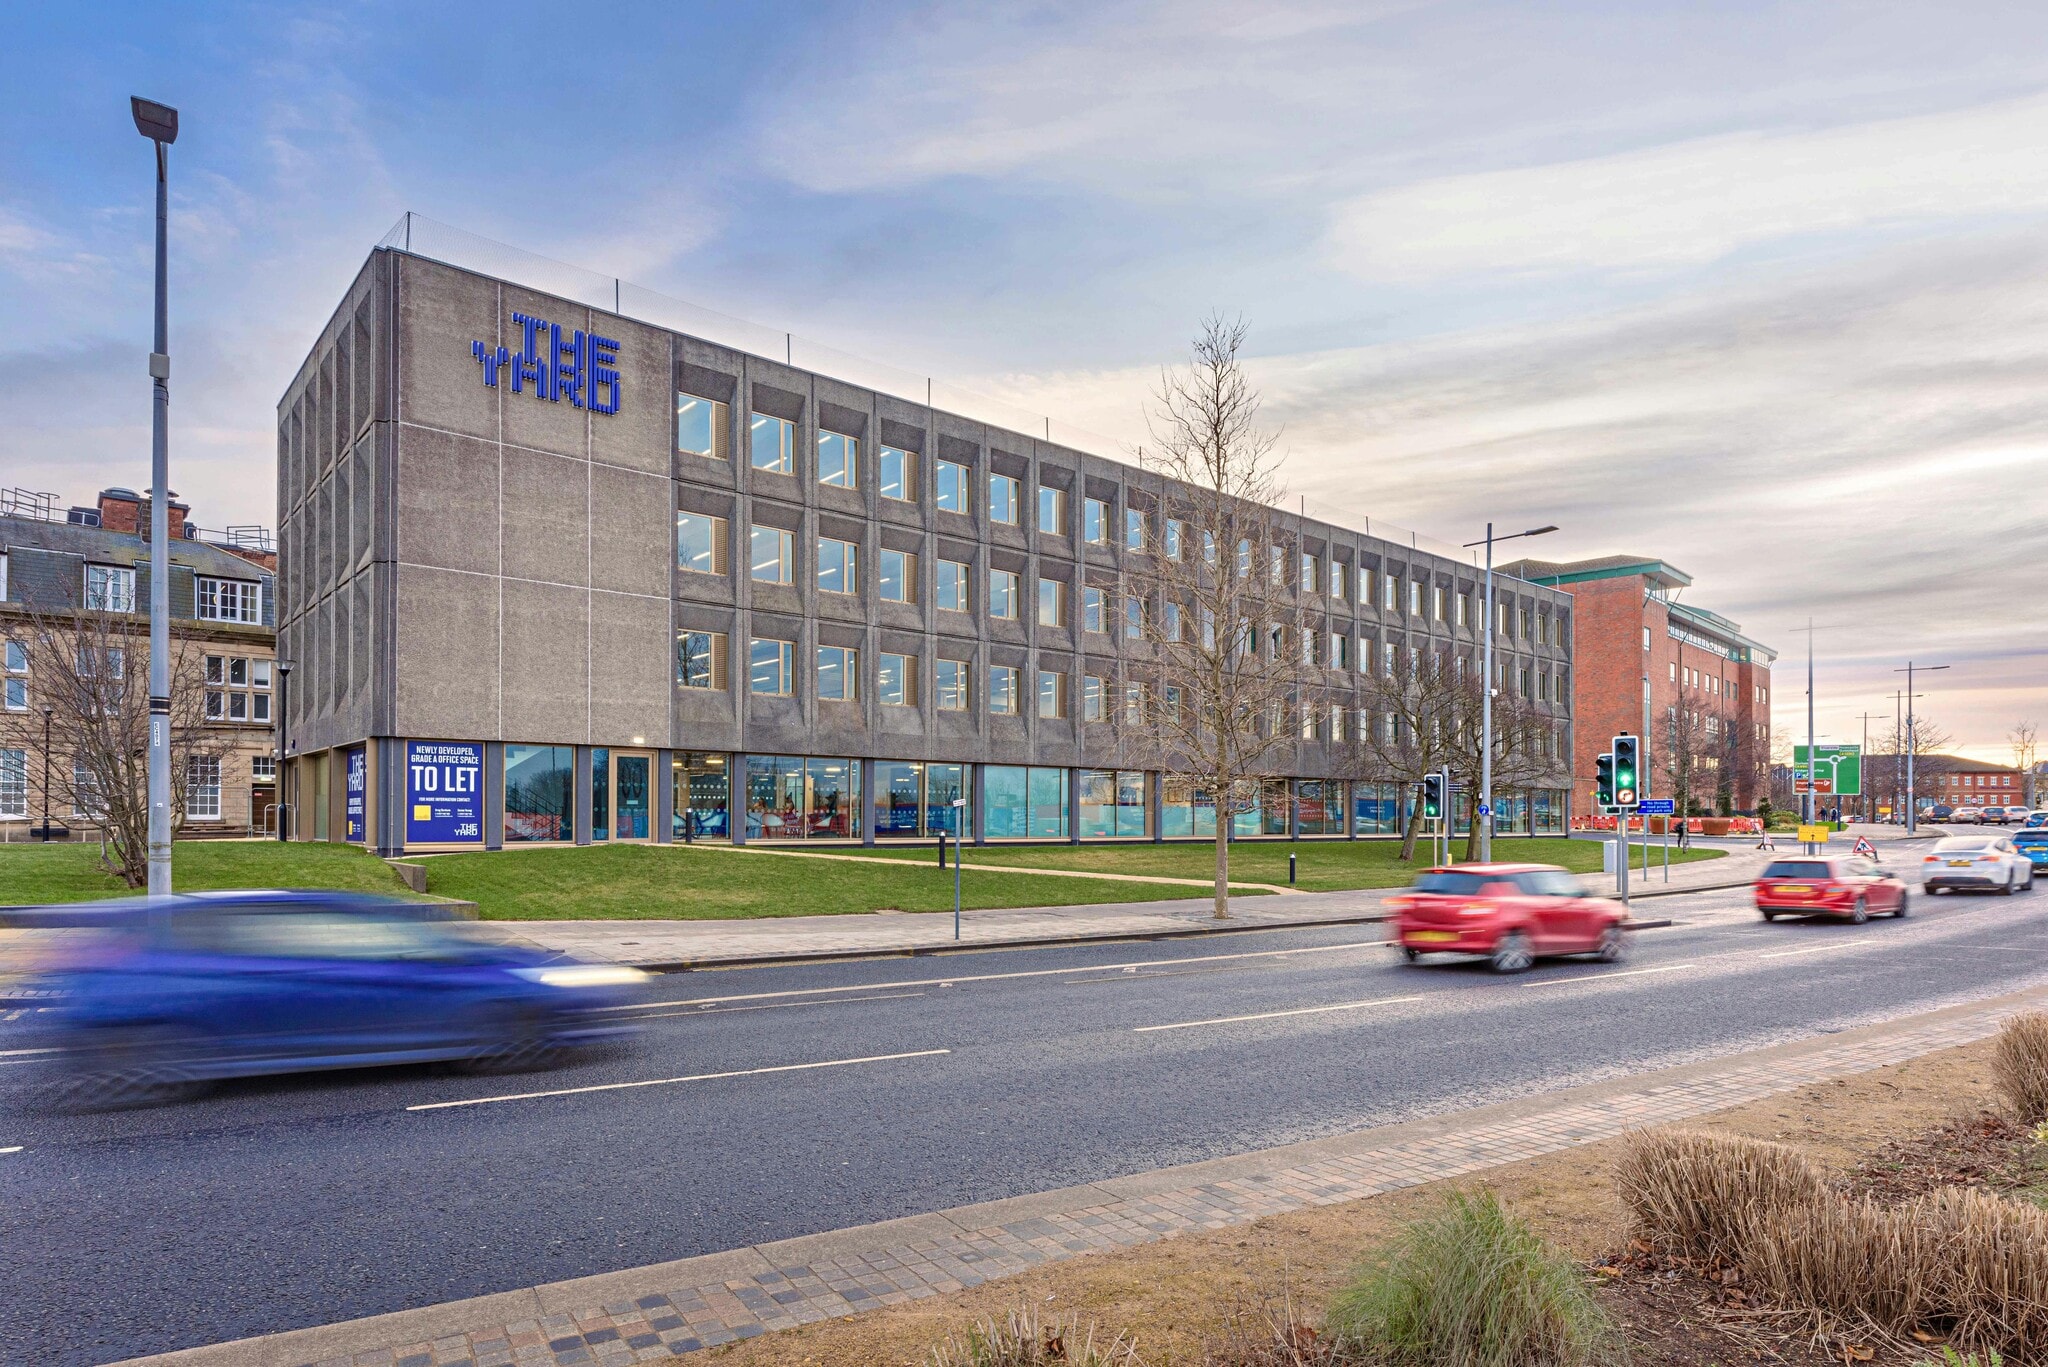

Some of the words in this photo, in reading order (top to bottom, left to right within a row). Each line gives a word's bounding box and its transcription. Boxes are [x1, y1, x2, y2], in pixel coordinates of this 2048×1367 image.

[511, 311, 620, 383] THE
[471, 340, 620, 416] YARD
[411, 754, 432, 763] GRADE
[433, 755, 438, 763] A
[438, 755, 459, 764] OFFICE
[459, 756, 479, 764] SPACE
[416, 745, 438, 754] NEWLY
[438, 746, 475, 756] DEVELOPED,
[351, 753, 364, 775] THE
[348, 773, 364, 791] YARD
[411, 765, 438, 791] TO
[445, 766, 479, 792] LET
[454, 828, 478, 836] YARD
